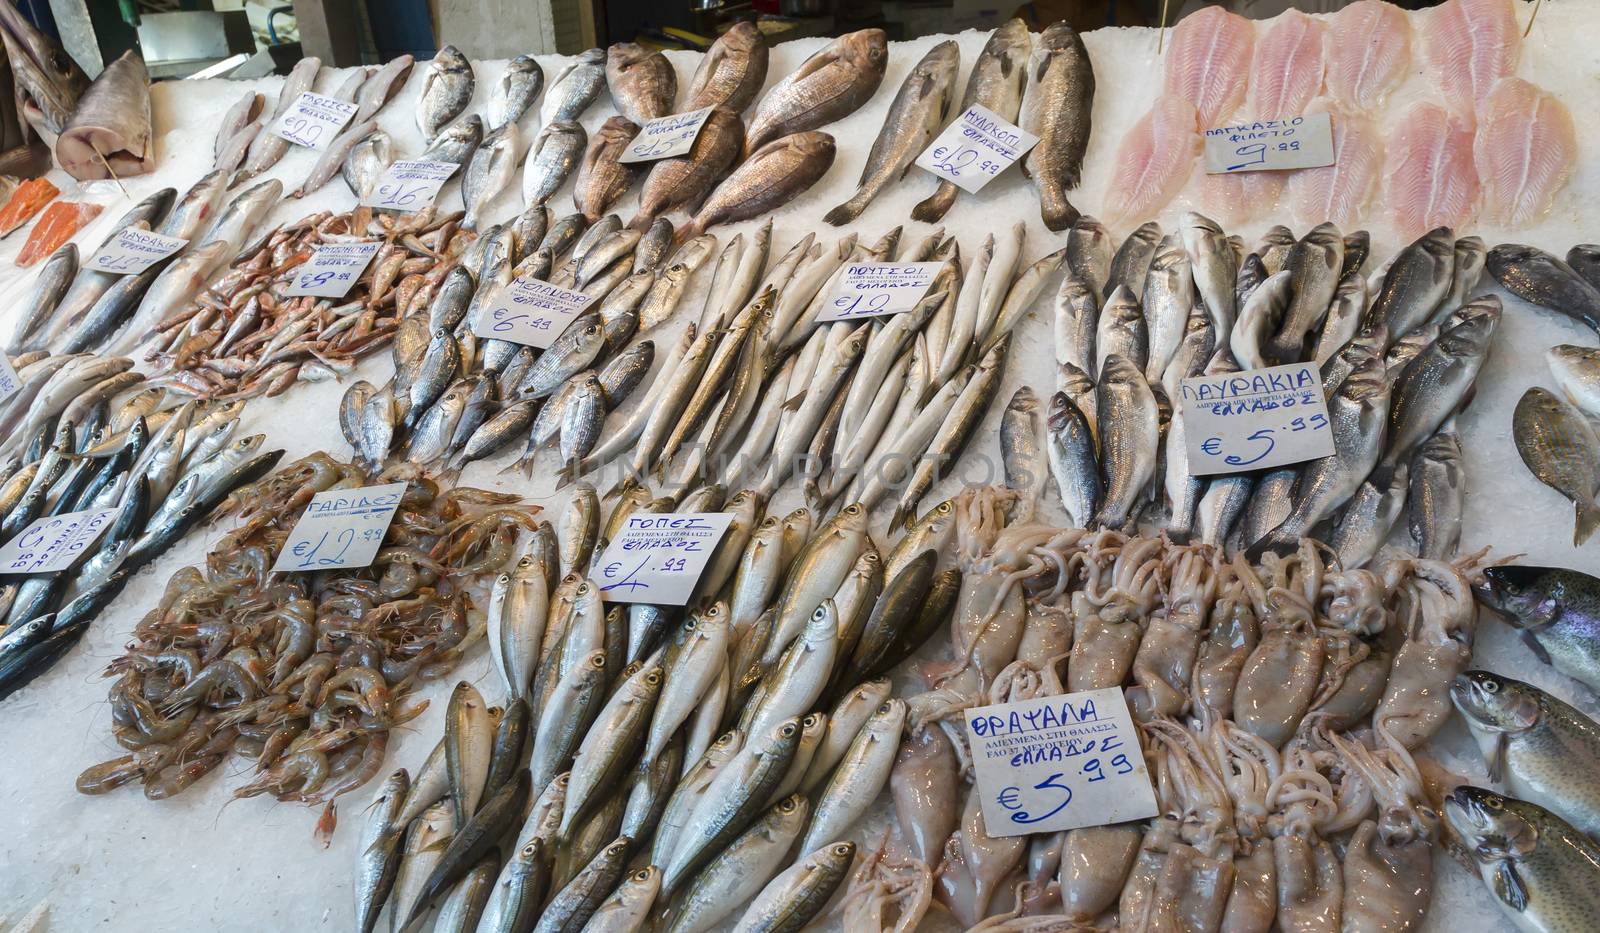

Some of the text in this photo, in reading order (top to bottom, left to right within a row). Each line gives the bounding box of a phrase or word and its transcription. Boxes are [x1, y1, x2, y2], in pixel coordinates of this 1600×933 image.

[1206, 117, 1303, 137] ΠΑΓΚΑΣΙΟ
[1228, 128, 1295, 142] ΦΙΛΕΤΟ
[1227, 140, 1300, 170] 9.99
[1183, 369, 1314, 400] ΛΑΥΡΑΚΙΑ
[308, 492, 401, 512] ΓΑΡΙΔΕΣ
[630, 518, 712, 529] ΓΟΠΕΣ
[971, 698, 1098, 737] ΘΡΑΨΑΛΑ
[985, 722, 1119, 749] ΑΛΙΕΥΜΕΝΑ ΣΤΗ ΘΑΛΑΣΣΑ
[1011, 735, 1124, 767] ΕΛΛΑΔΟΣ
